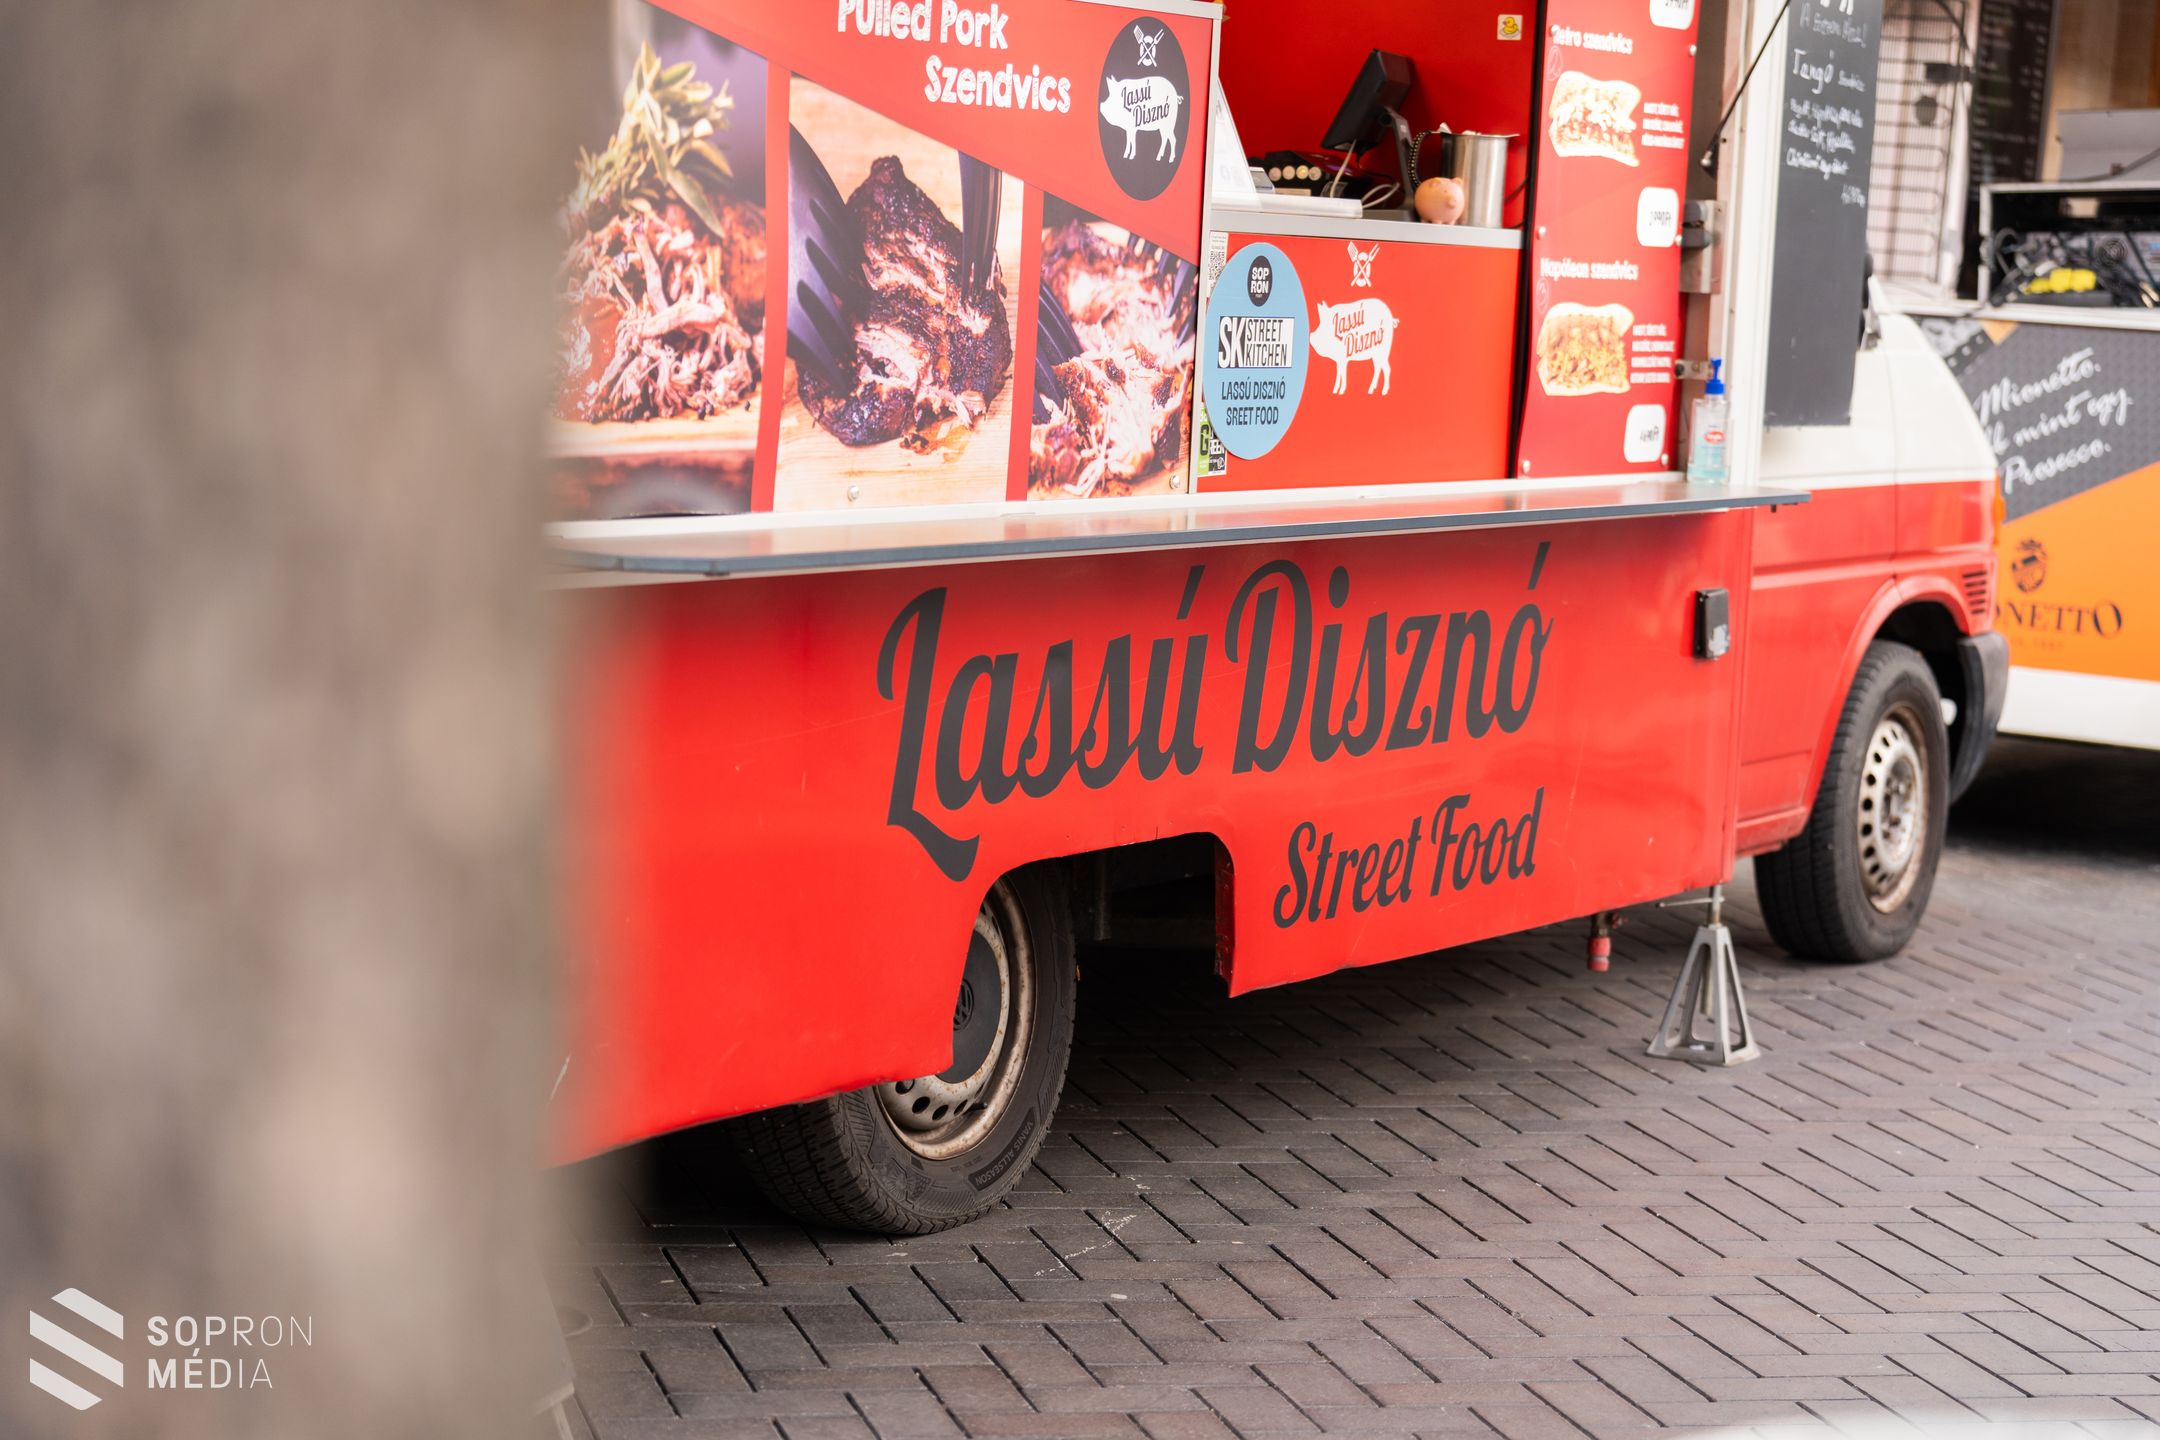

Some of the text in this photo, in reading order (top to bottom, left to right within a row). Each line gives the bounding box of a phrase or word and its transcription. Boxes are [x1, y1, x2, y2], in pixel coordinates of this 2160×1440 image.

[940, 0, 1009, 50] Pork
[924, 55, 1072, 114] Szendvics
[1120, 79, 1152, 113] Lassú
[1132, 96, 1170, 128] Disznó
[1250, 280, 1269, 294] RON
[1251, 266, 1269, 281] SOP
[1332, 303, 1365, 341] Lassú
[1343, 320, 1384, 358] Disznó
[1218, 316, 1284, 369] SK STREET
[1245, 343, 1288, 367] KITCHEN
[1221, 376, 1286, 401] LASSÚ DISZNÓ
[1226, 406, 1279, 426] SREET FOOD
[2013, 390, 2093, 447] mint
[2086, 388, 2134, 427] egy
[1996, 600, 2123, 639] NETTO
[876, 541, 1554, 882] Lassú Disznó
[1273, 786, 1546, 930] Street Food
[975, 1150, 1015, 1186] ALLSEASON
